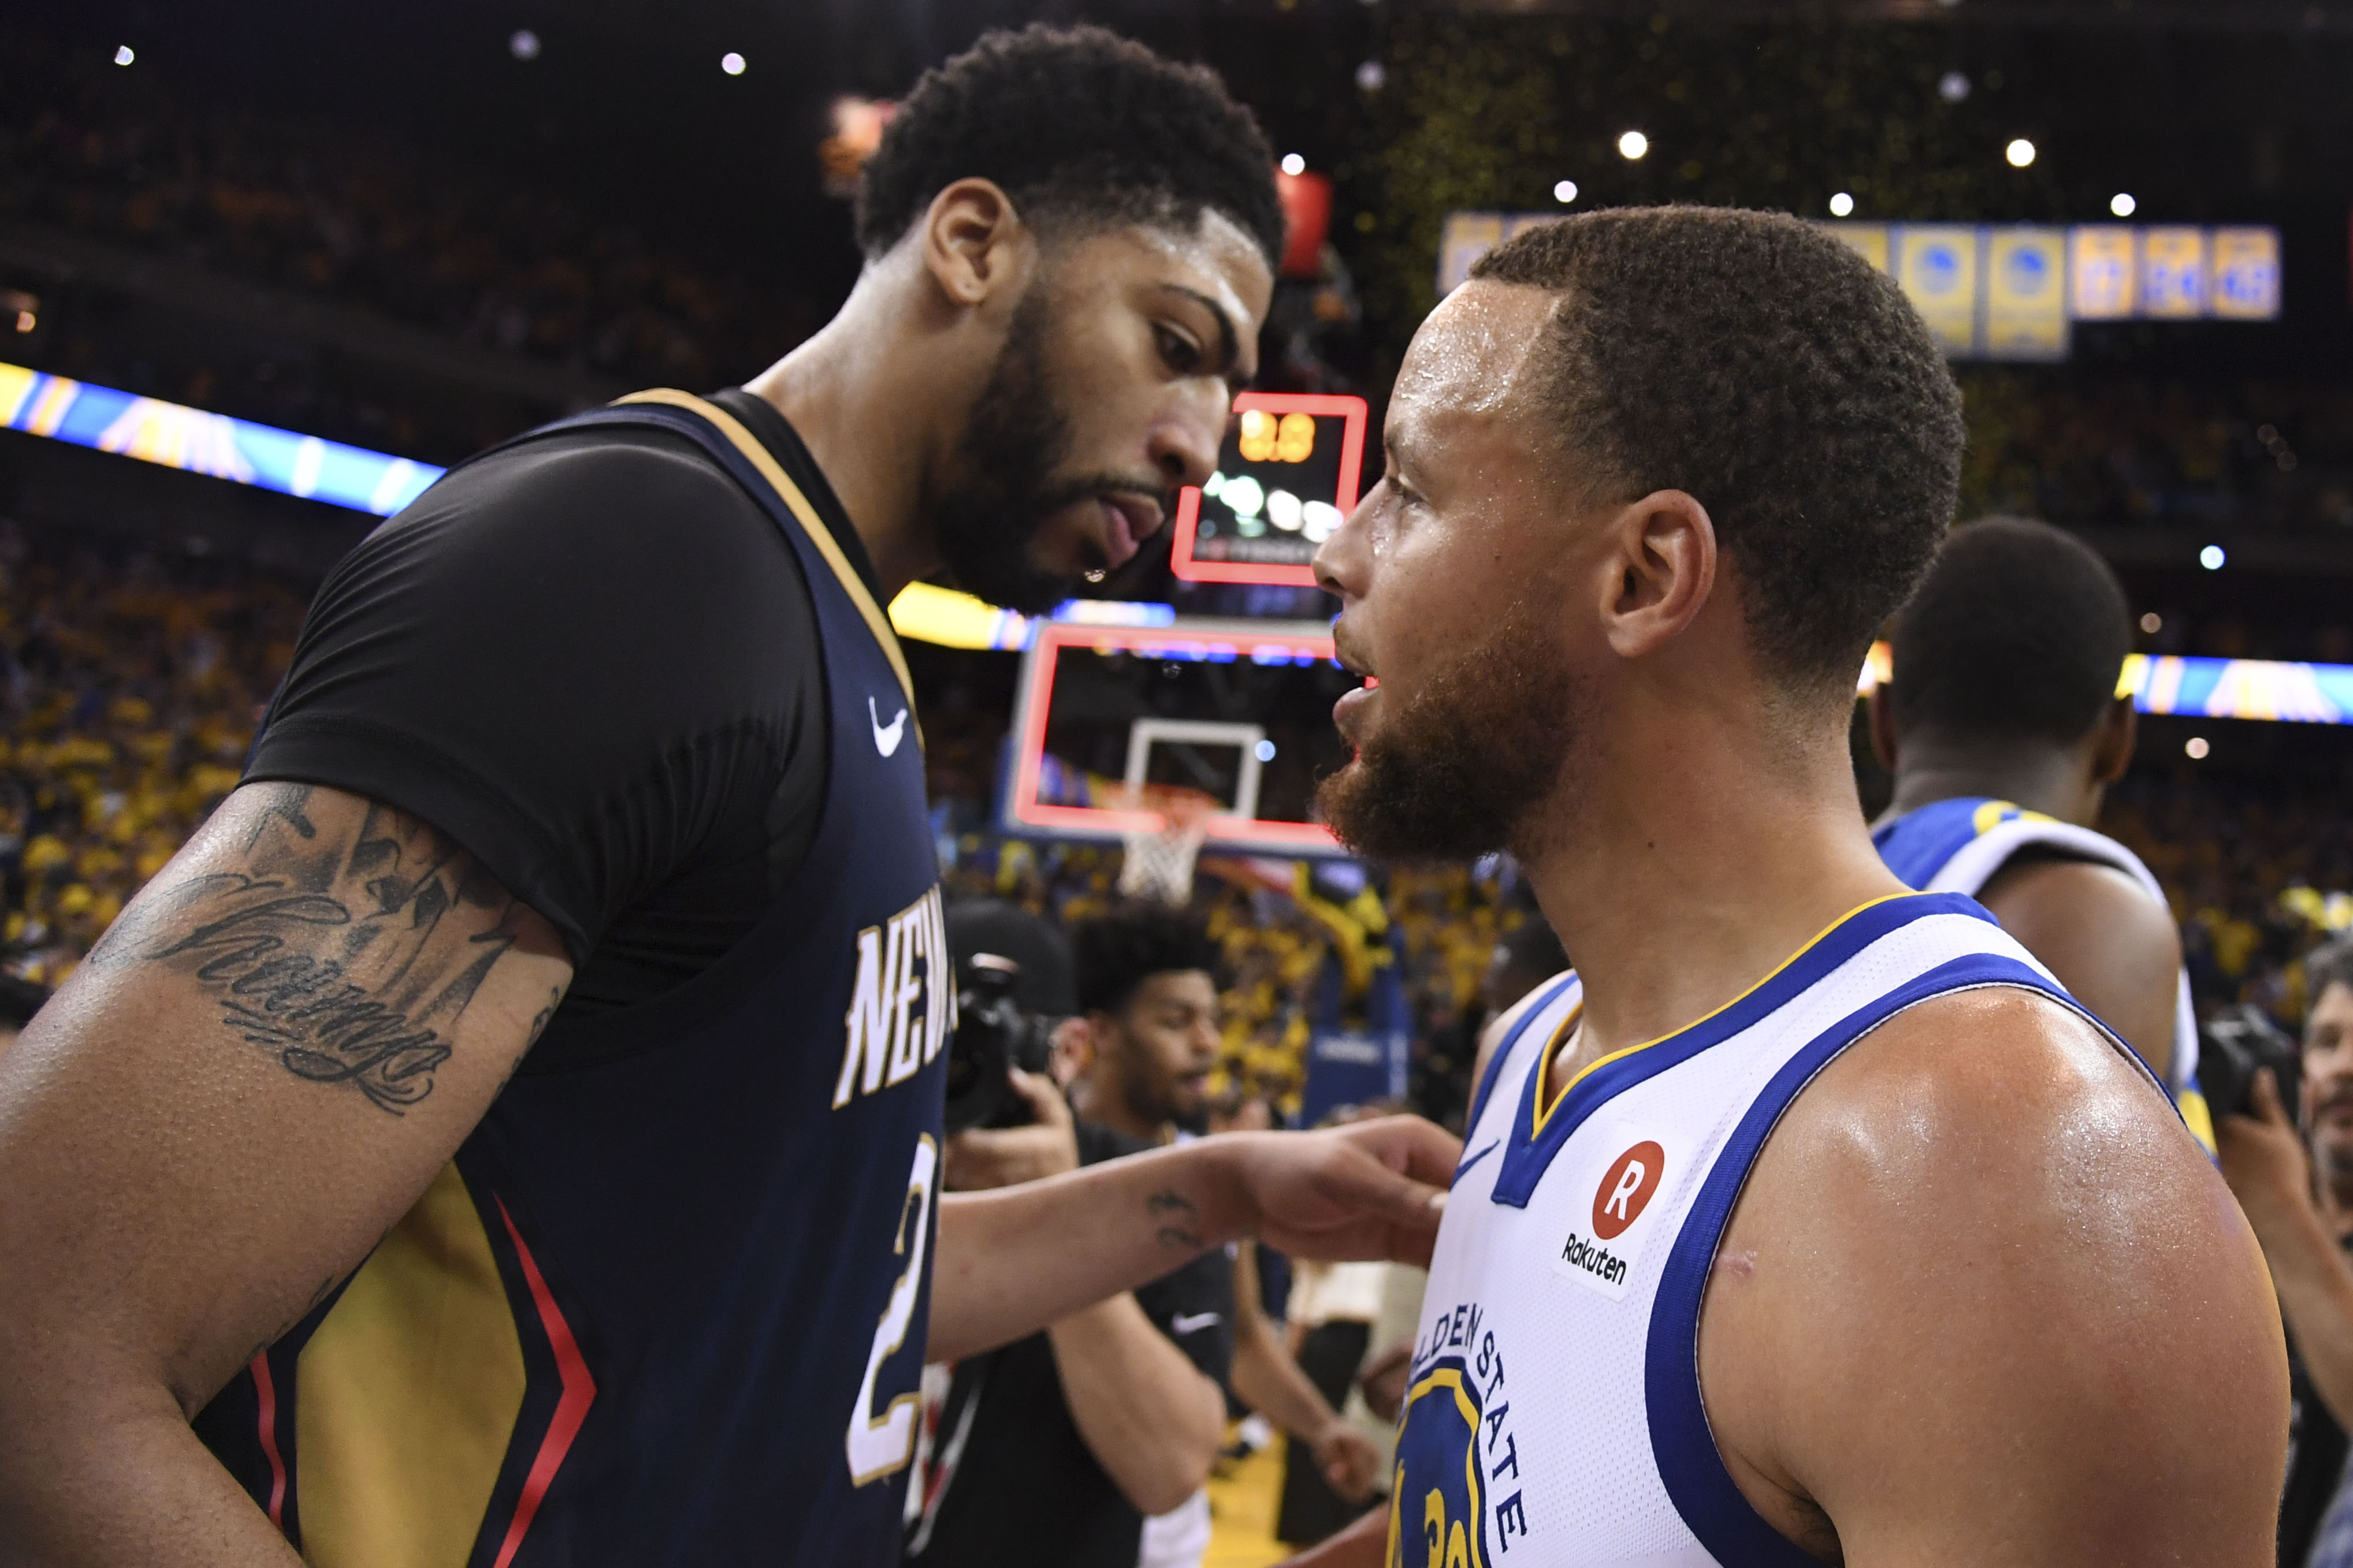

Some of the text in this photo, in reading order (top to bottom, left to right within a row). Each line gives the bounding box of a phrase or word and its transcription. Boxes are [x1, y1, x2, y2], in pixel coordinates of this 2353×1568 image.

[831, 882, 953, 1111] NEW
[1562, 1232, 1627, 1286] Rakuten
[1604, 1159, 1645, 1220] R
[845, 1132, 938, 1488] 2
[1411, 1302, 1527, 1554] LDEN STATE
